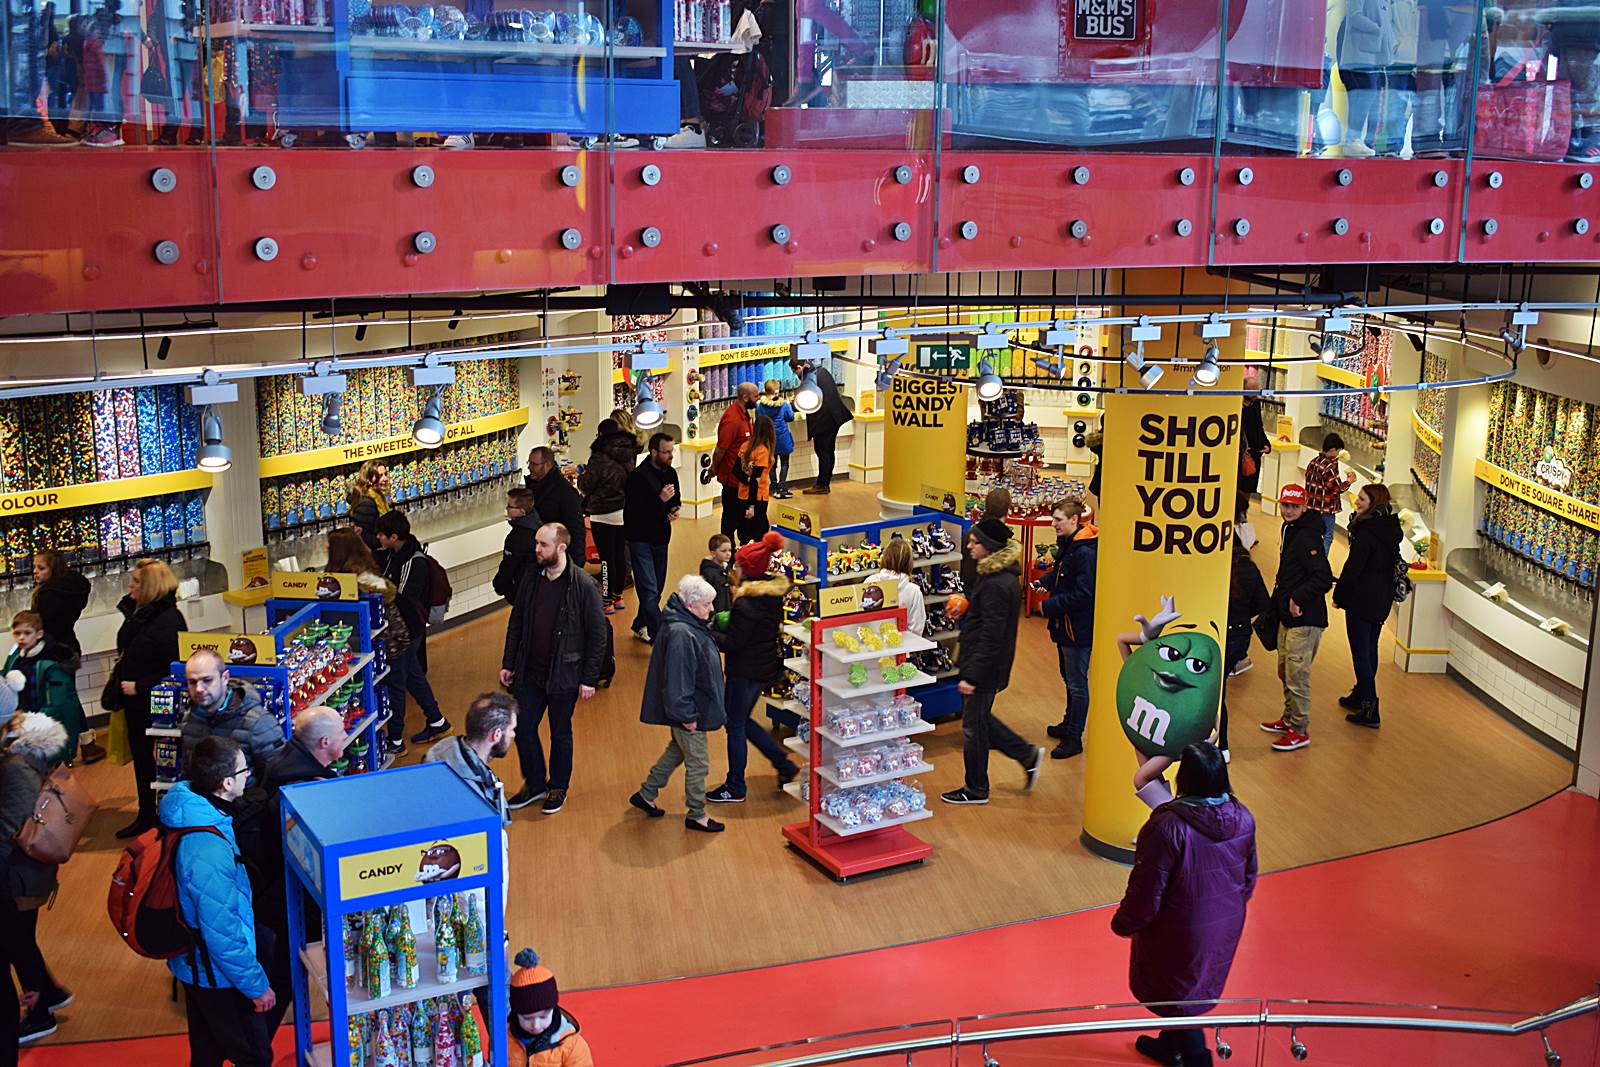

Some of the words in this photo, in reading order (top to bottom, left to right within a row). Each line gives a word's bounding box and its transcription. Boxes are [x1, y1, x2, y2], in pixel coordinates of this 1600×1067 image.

[1078, 0, 1134, 15] M&MS
[1086, 16, 1125, 36] BUS
[720, 350, 740, 361] DON'T
[741, 349, 749, 358] BE
[750, 346, 778, 358] SQUARE,
[892, 394, 955, 412] CANDY
[892, 410, 944, 428] WALL
[1138, 413, 1239, 448] SHOP
[343, 447, 364, 460] THE
[447, 427, 459, 439] OF
[460, 424, 476, 436] ALL
[1137, 449, 1221, 484] TILL
[1541, 463, 1567, 480] CRISPY
[0, 493, 59, 511] OLOUR
[1136, 484, 1222, 520] YOU
[1500, 474, 1520, 492] DON'T
[1521, 484, 1531, 497] BE
[1532, 488, 1565, 514] SQUARE,
[1567, 502, 1600, 526] SHARE!
[1133, 519, 1233, 555] DROP
[282, 581, 308, 589] CANDY
[830, 595, 854, 605] CANDY
[190, 643, 219, 651] CANDY
[1126, 695, 1171, 748] m
[359, 863, 403, 880] CANDY
